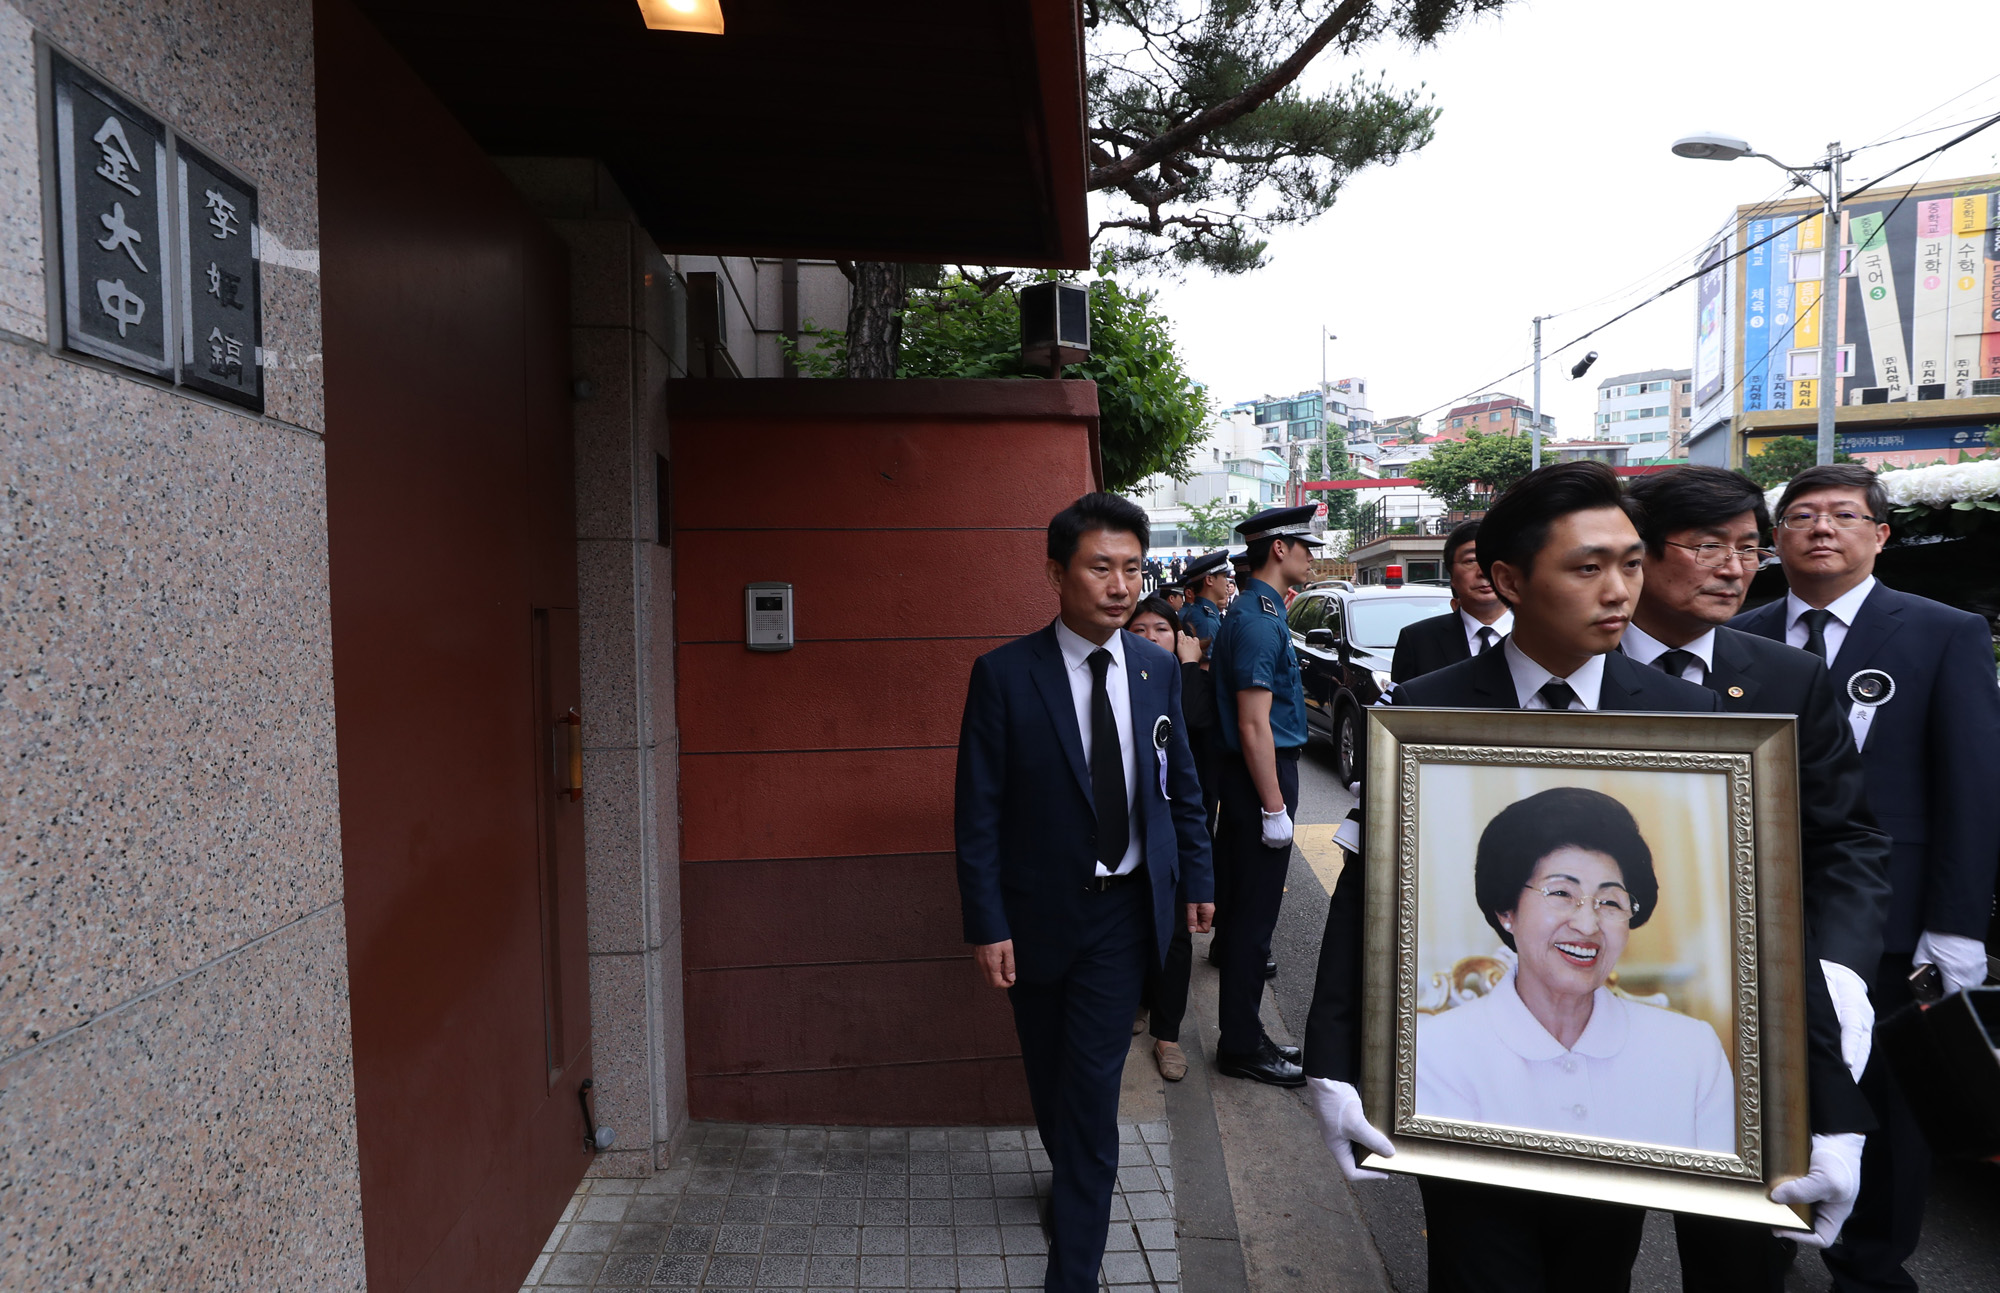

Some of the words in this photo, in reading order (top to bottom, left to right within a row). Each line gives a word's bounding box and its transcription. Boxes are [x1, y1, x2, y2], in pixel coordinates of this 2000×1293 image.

[93, 116, 148, 337] 金大中
[1927, 203, 1939, 234] 중학교
[1963, 198, 1975, 230] 중학교
[1751, 223, 1766, 267] 초등학교
[1778, 220, 1791, 264] 초등학교
[1804, 217, 1816, 249] 초등학
[1862, 217, 1876, 248] 중학교
[1865, 254, 1884, 284] 국어
[1924, 242, 1942, 274] 과학
[1958, 243, 1976, 274] 수학
[1751, 288, 1766, 314] 체육
[1775, 285, 1790, 311] 체육
[1872, 288, 1884, 299] 3
